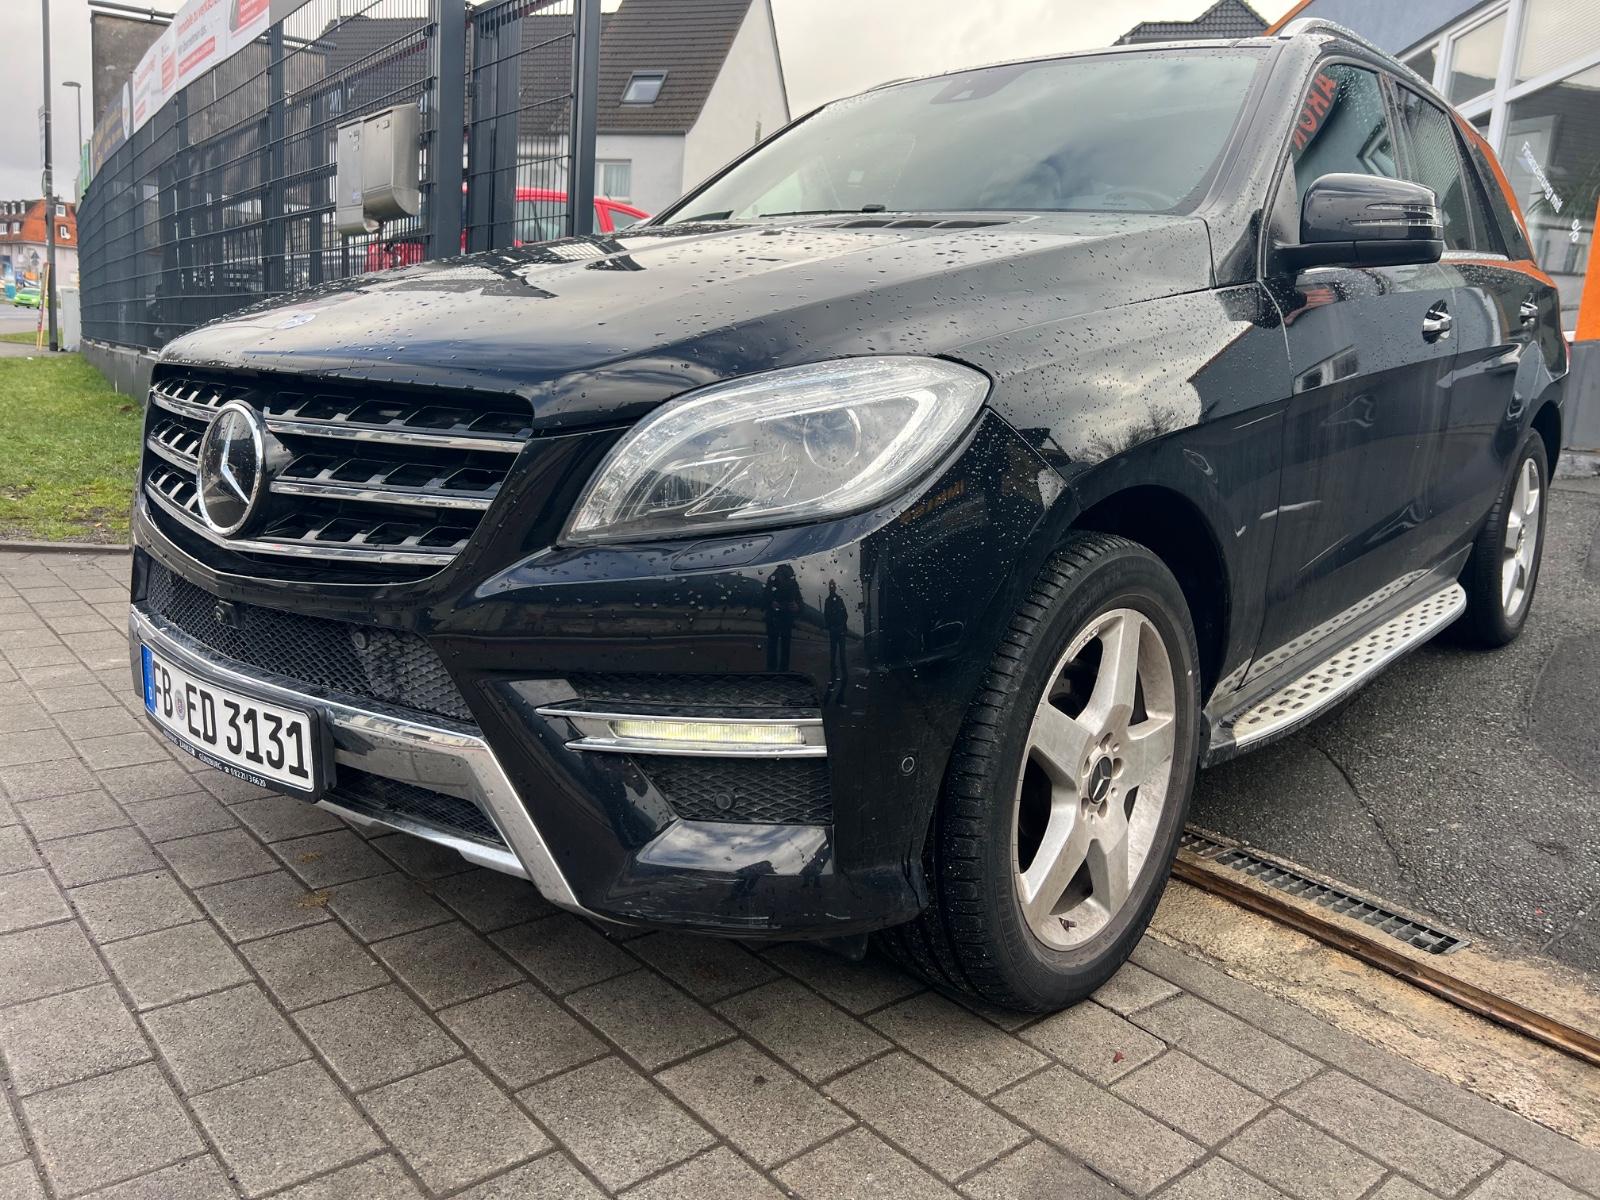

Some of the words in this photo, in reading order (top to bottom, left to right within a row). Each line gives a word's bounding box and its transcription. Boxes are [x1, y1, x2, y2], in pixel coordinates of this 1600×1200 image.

[1569, 219, 1583, 242] %
[153, 660, 173, 718] FB
[185, 682, 217, 745] ED
[223, 699, 309, 779] 3131
